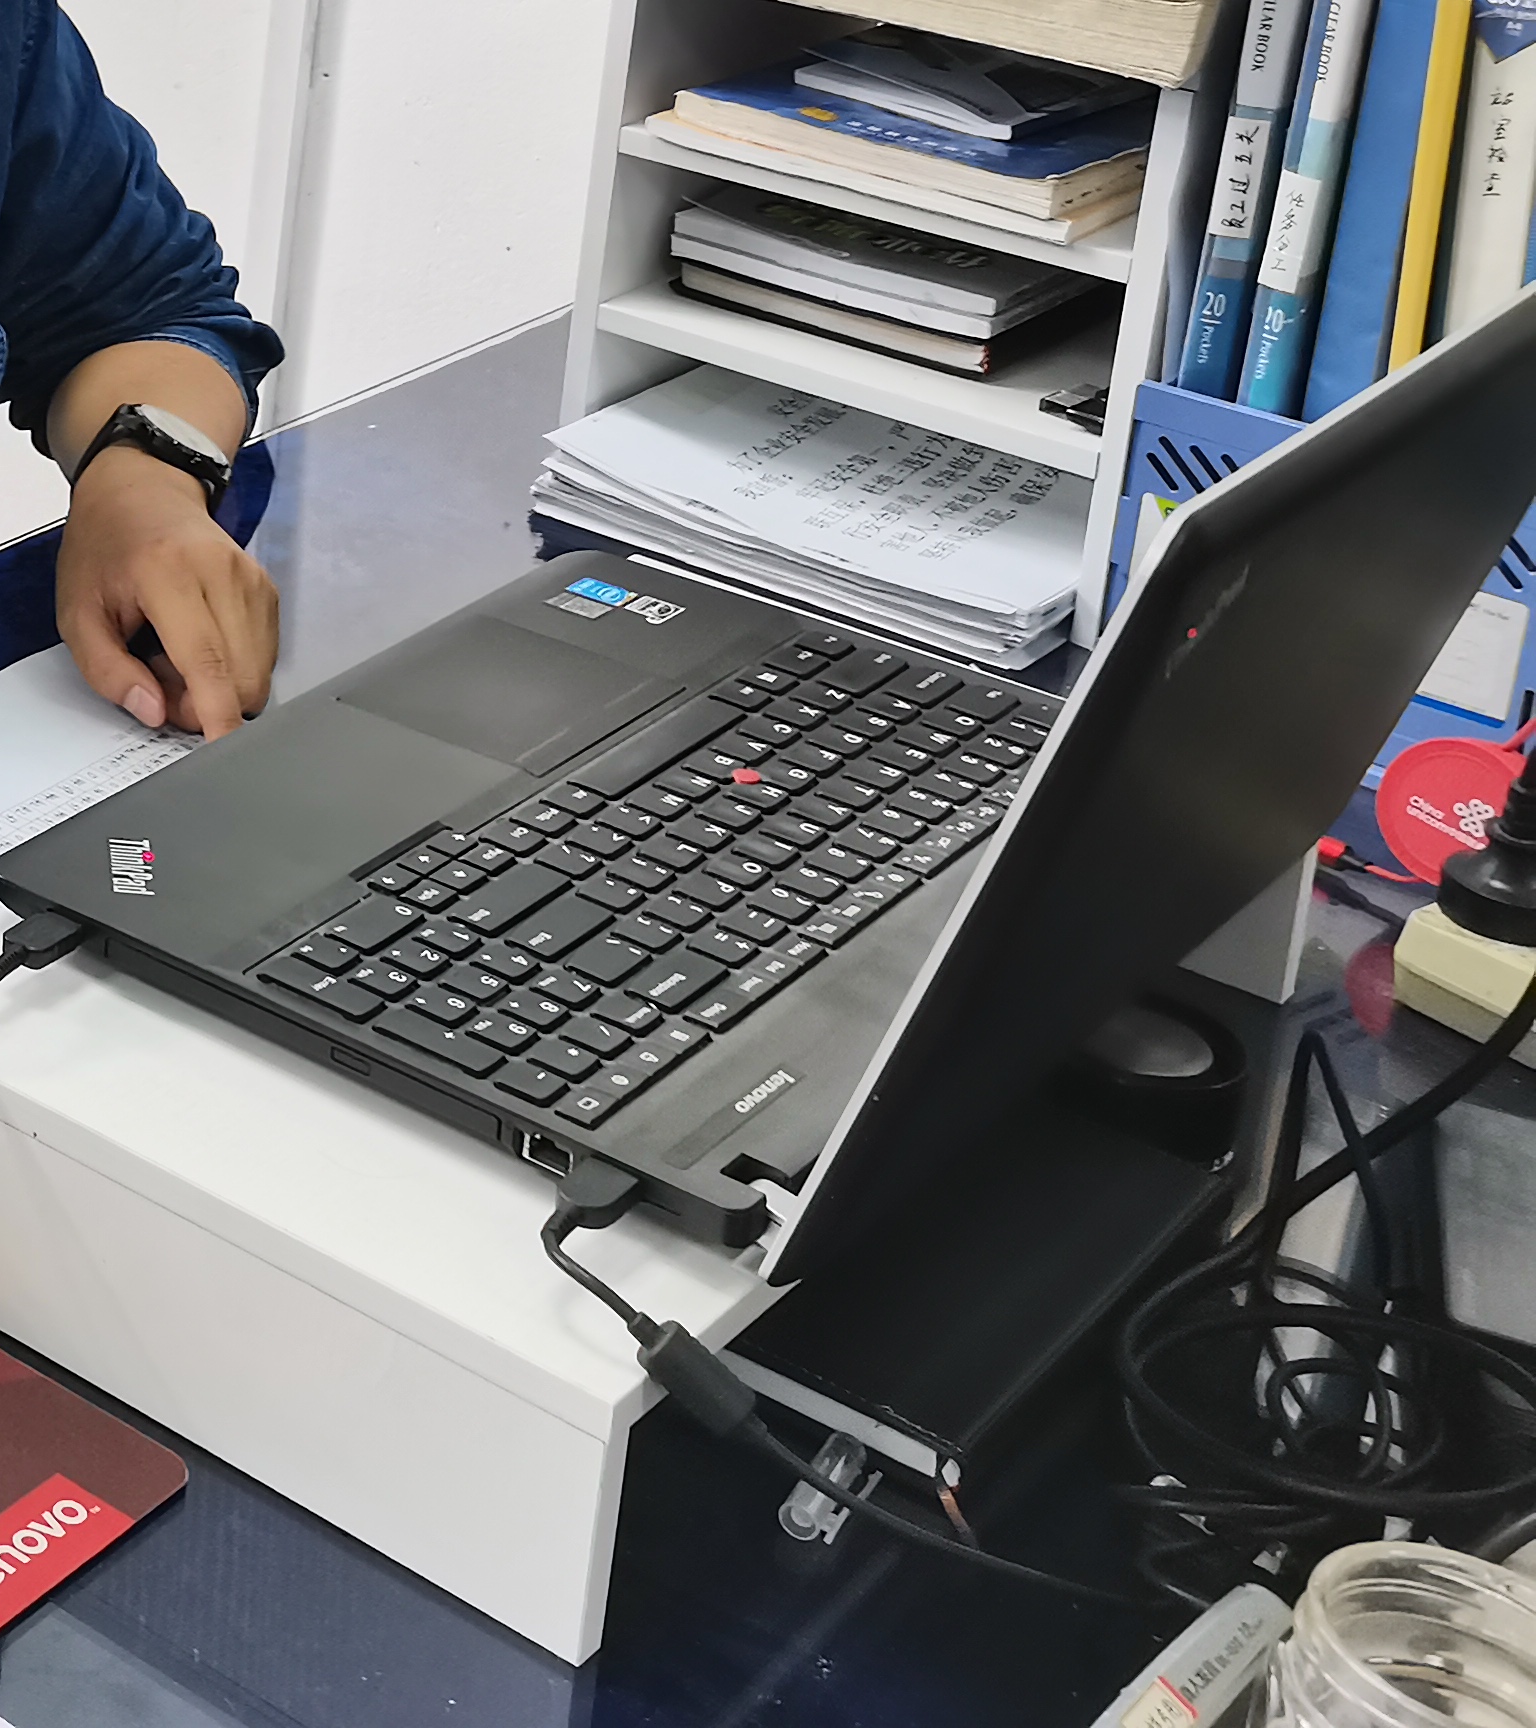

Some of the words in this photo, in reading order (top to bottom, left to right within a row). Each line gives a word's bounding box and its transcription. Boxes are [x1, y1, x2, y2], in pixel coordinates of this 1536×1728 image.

[1324, 1, 1342, 44] CLEAR
[1250, 38, 1272, 73] BOOK
[1316, 44, 1332, 83] BOOK
[1201, 291, 1226, 318] 20
[108, 837, 155, 897] ThinkPad
[734, 1067, 796, 1114] lenovo
